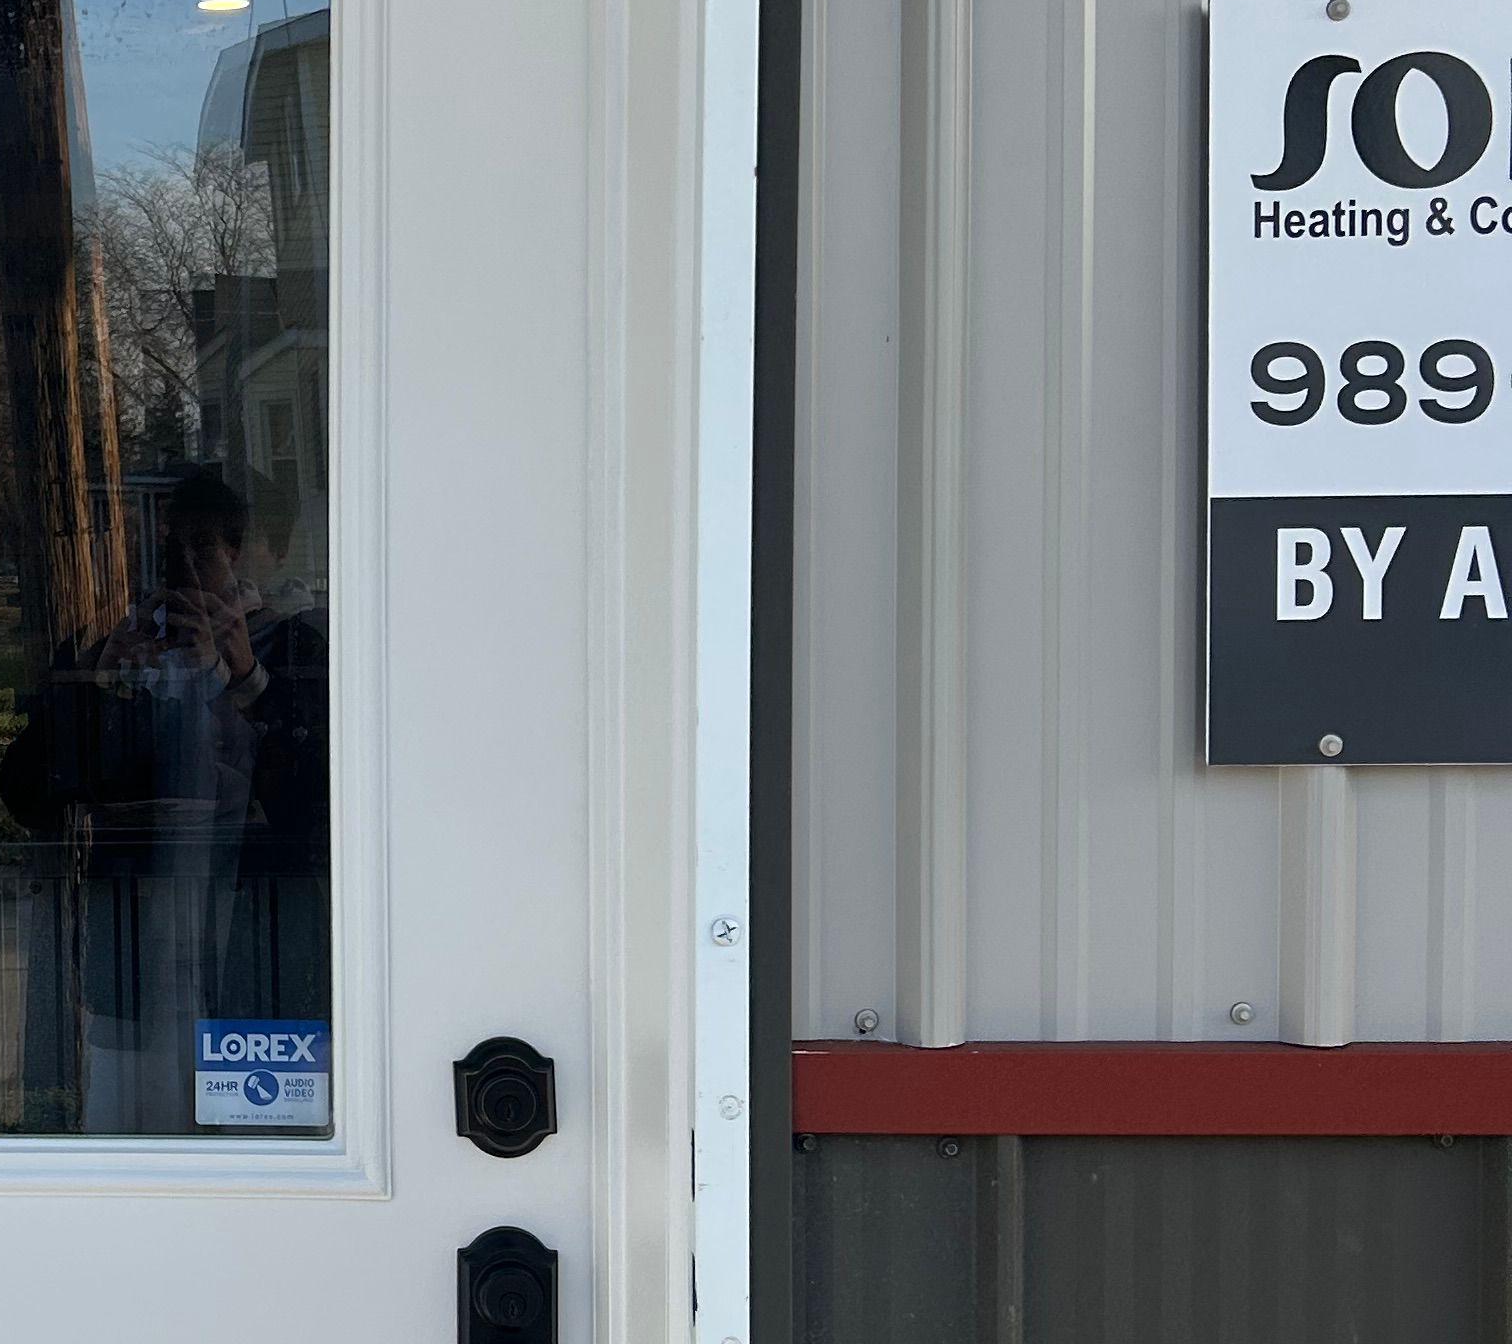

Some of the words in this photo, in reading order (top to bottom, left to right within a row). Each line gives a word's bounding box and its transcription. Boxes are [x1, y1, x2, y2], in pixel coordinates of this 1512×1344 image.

[1250, 50, 1512, 193] SO
[1253, 198, 1411, 248] Heating
[1424, 197, 1455, 237] &
[1276, 526, 1407, 622] BY
[202, 1032, 316, 1062] LOREX
[205, 1080, 238, 1092] 24HR
[283, 1078, 315, 1088] AUDIO
[284, 1088, 315, 1098] VIDEO
